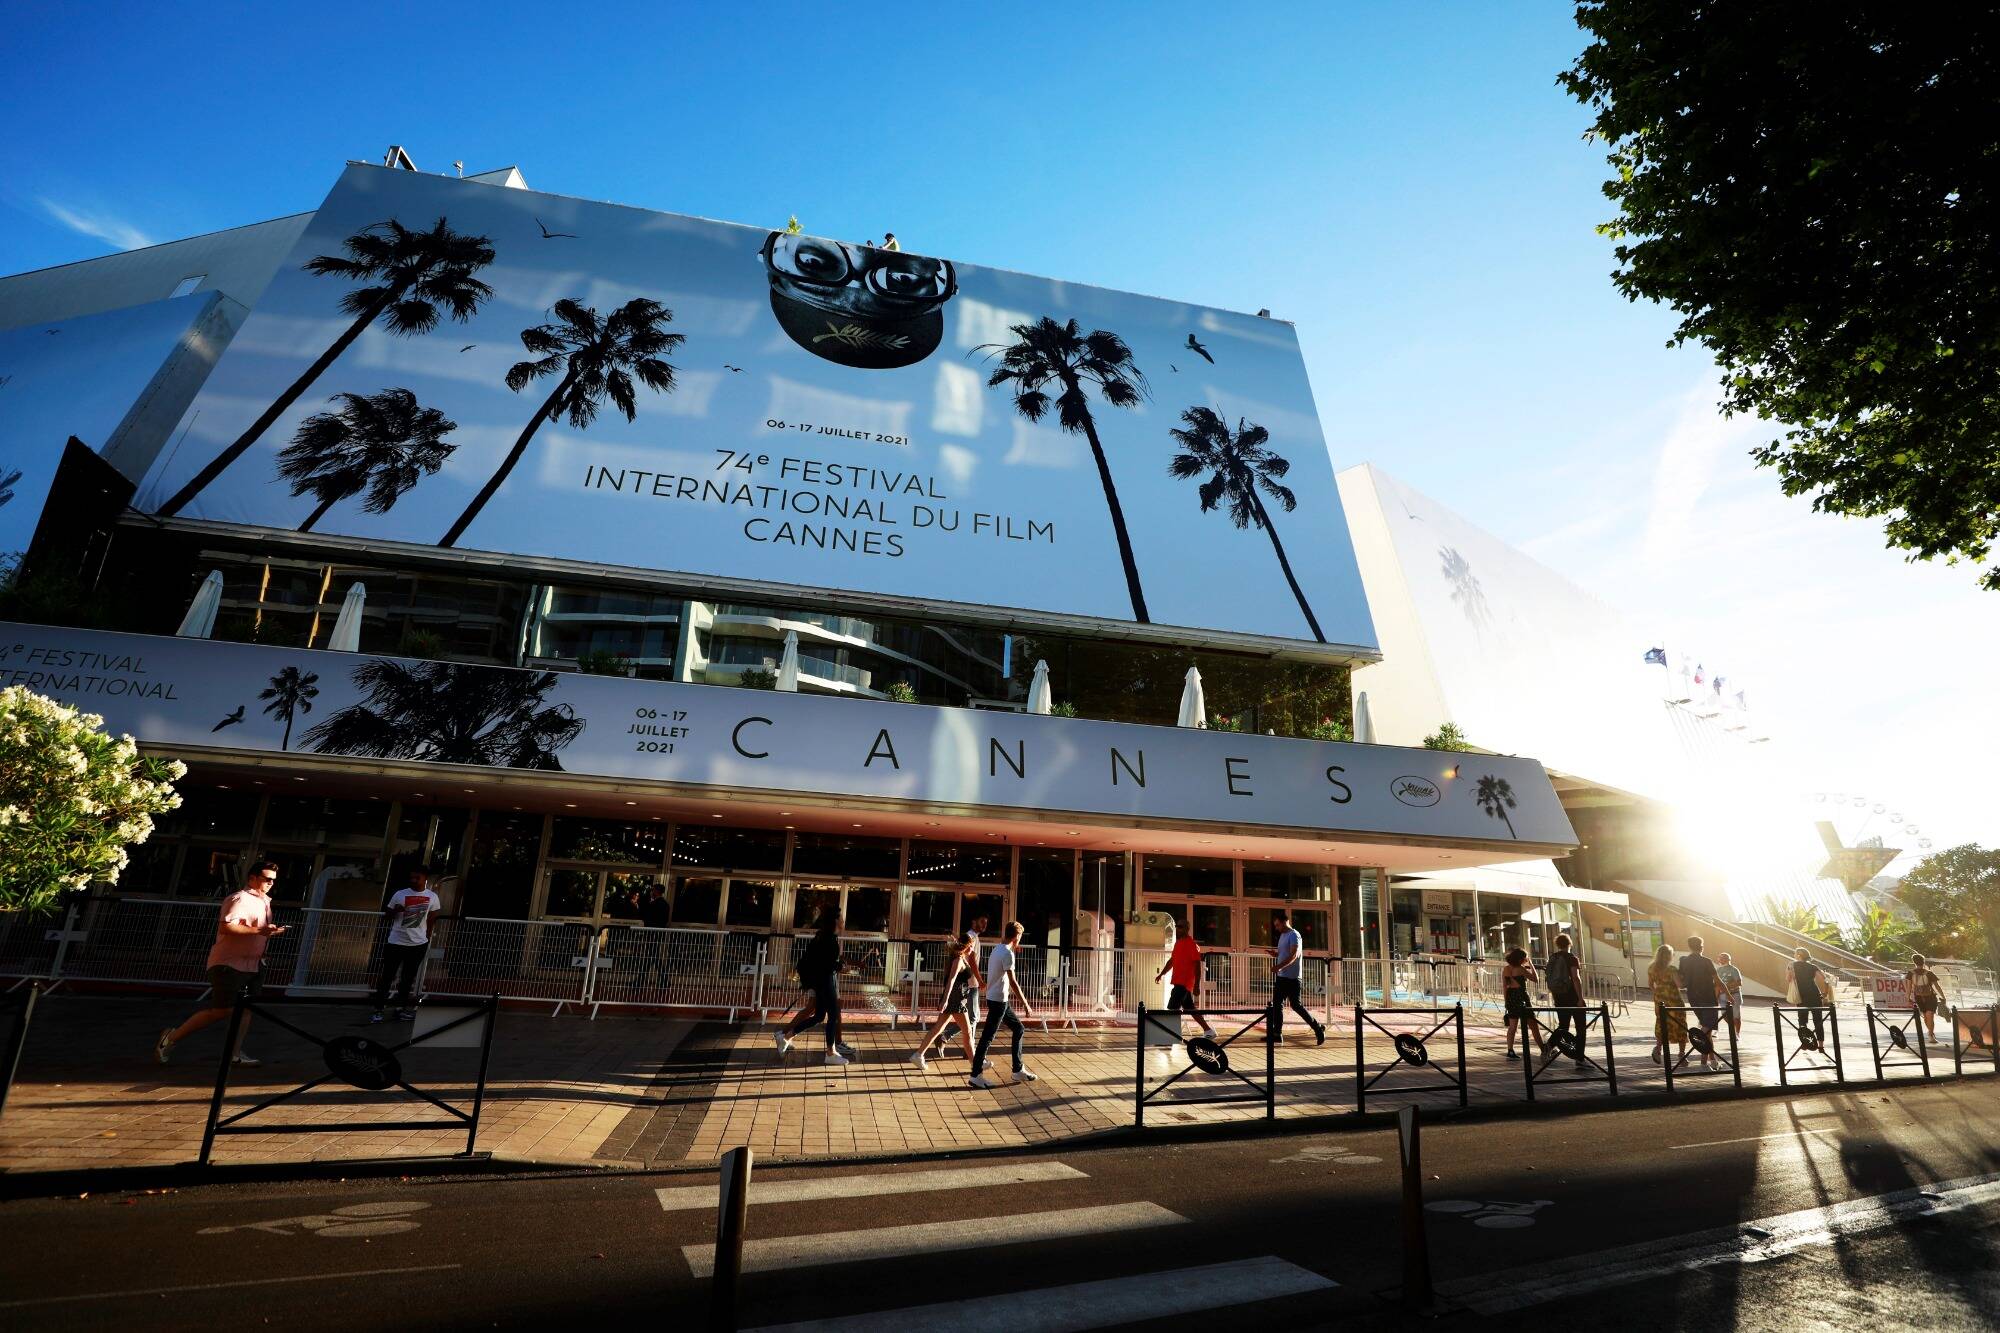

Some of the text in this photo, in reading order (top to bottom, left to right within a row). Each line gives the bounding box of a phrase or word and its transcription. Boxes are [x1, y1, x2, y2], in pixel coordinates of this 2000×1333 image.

[767, 418, 786, 430] 06
[799, 423, 813, 433] 17
[817, 426, 871, 441] JUILLET
[876, 433, 908, 446] 2021
[780, 457, 946, 499] FESTIVAL
[584, 465, 1054, 543] INTERNATIONAL DU FILM
[744, 518, 904, 557] CANNES
[26, 648, 147, 674] FESTIVAL
[636, 708, 657, 719] 06
[673, 711, 687, 721] 17
[627, 724, 690, 738] JUILLET
[636, 741, 674, 753] 2021
[731, 716, 1354, 804] CANNES
[1427, 903, 1451, 911] ENTRANCE
